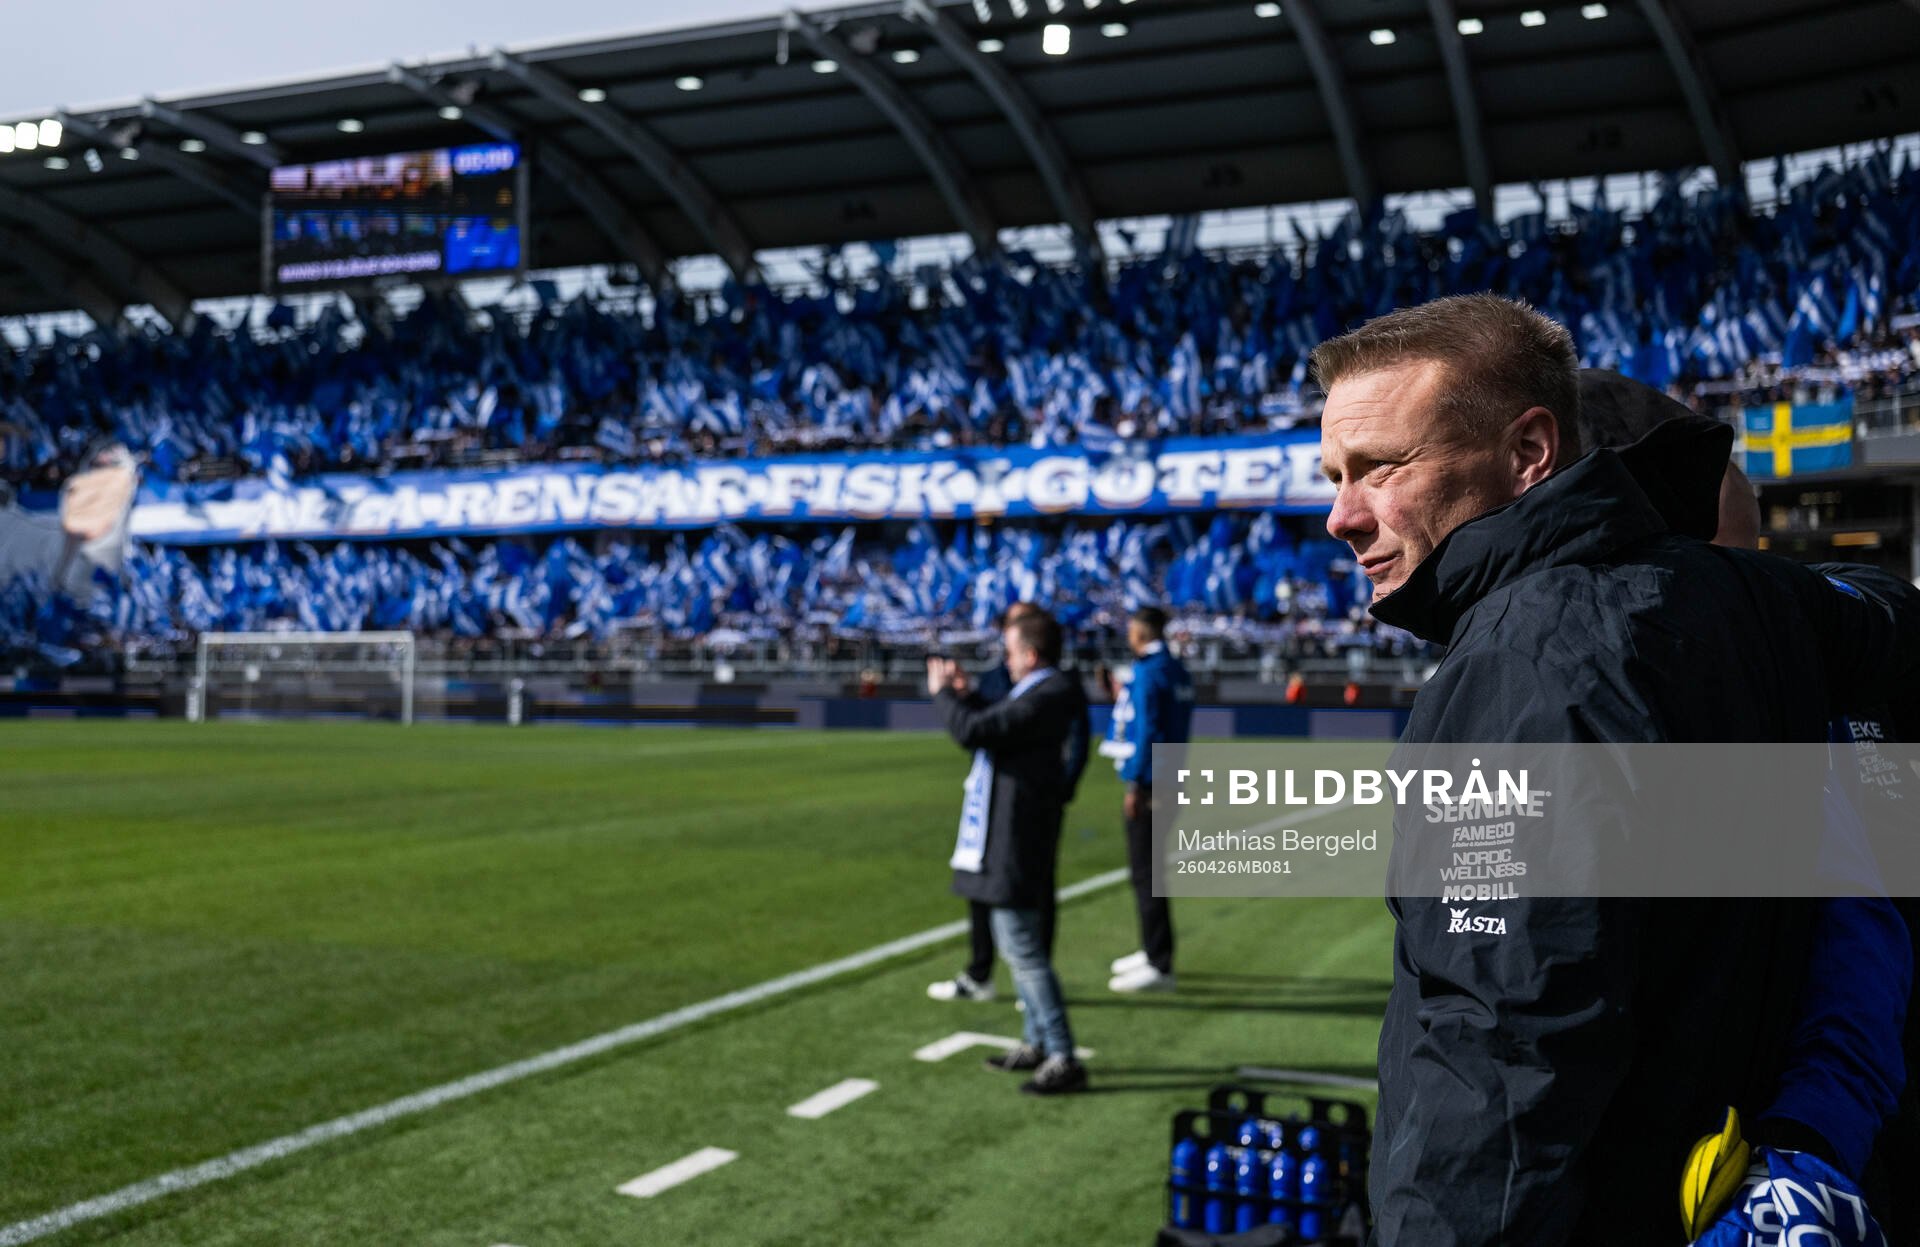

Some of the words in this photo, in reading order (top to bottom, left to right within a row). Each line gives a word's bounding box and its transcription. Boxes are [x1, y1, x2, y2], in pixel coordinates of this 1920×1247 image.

[437, 466, 748, 526] RENSAR
[762, 460, 957, 515] FISK
[1849, 721, 1883, 739] EKE
[1452, 821, 1515, 842] FAMECO
[1453, 848, 1511, 866] NORDIC
[1440, 862, 1527, 881] WELLNESS
[1442, 882, 1519, 904] MOBILL
[1447, 916, 1507, 935] RASTA
